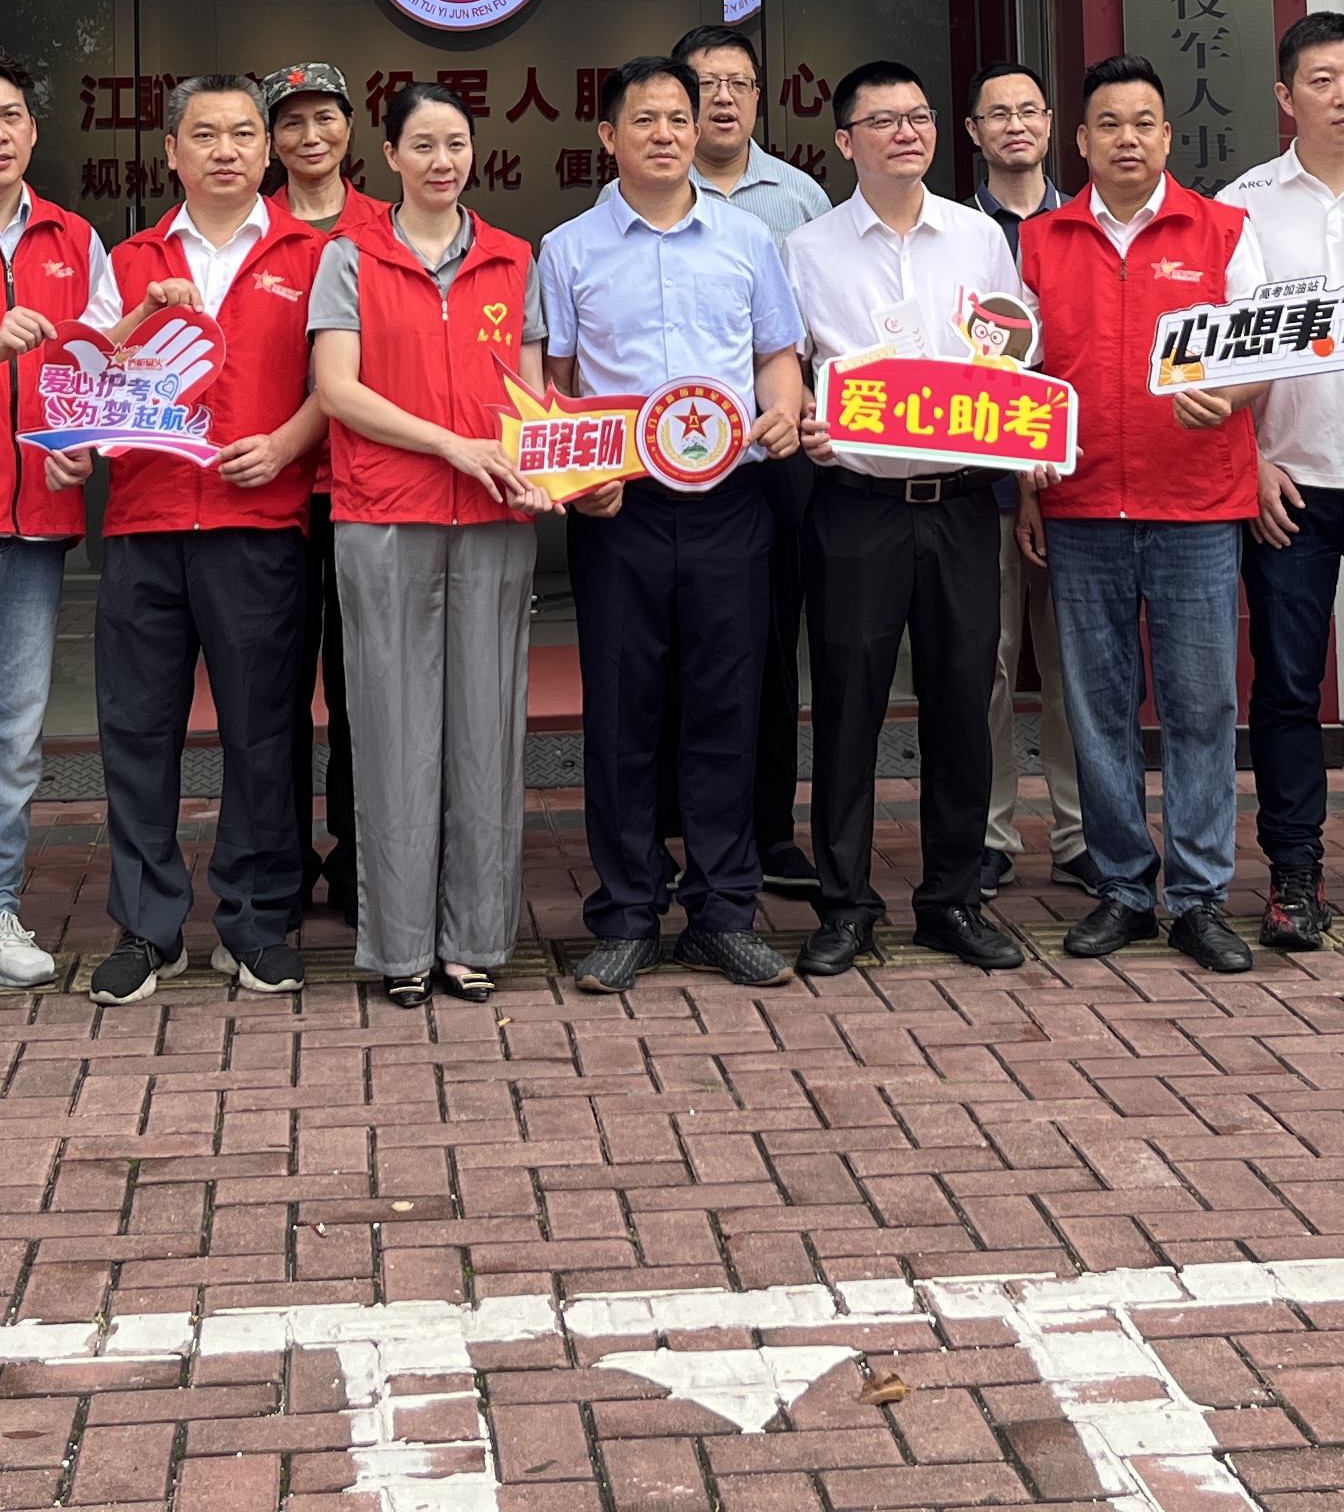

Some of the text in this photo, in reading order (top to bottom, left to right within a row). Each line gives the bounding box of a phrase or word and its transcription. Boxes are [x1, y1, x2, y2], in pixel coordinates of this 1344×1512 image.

[419, 0, 436, 14] TUI
[448, 7, 470, 19] JUN
[471, 5, 494, 18] REN
[1259, 281, 1320, 300] 高考加油站
[40, 365, 153, 402] 爱心护考
[74, 401, 187, 432] 为梦起航
[838, 378, 1054, 450] 爱心助考
[520, 417, 626, 473] 雷锋车队
